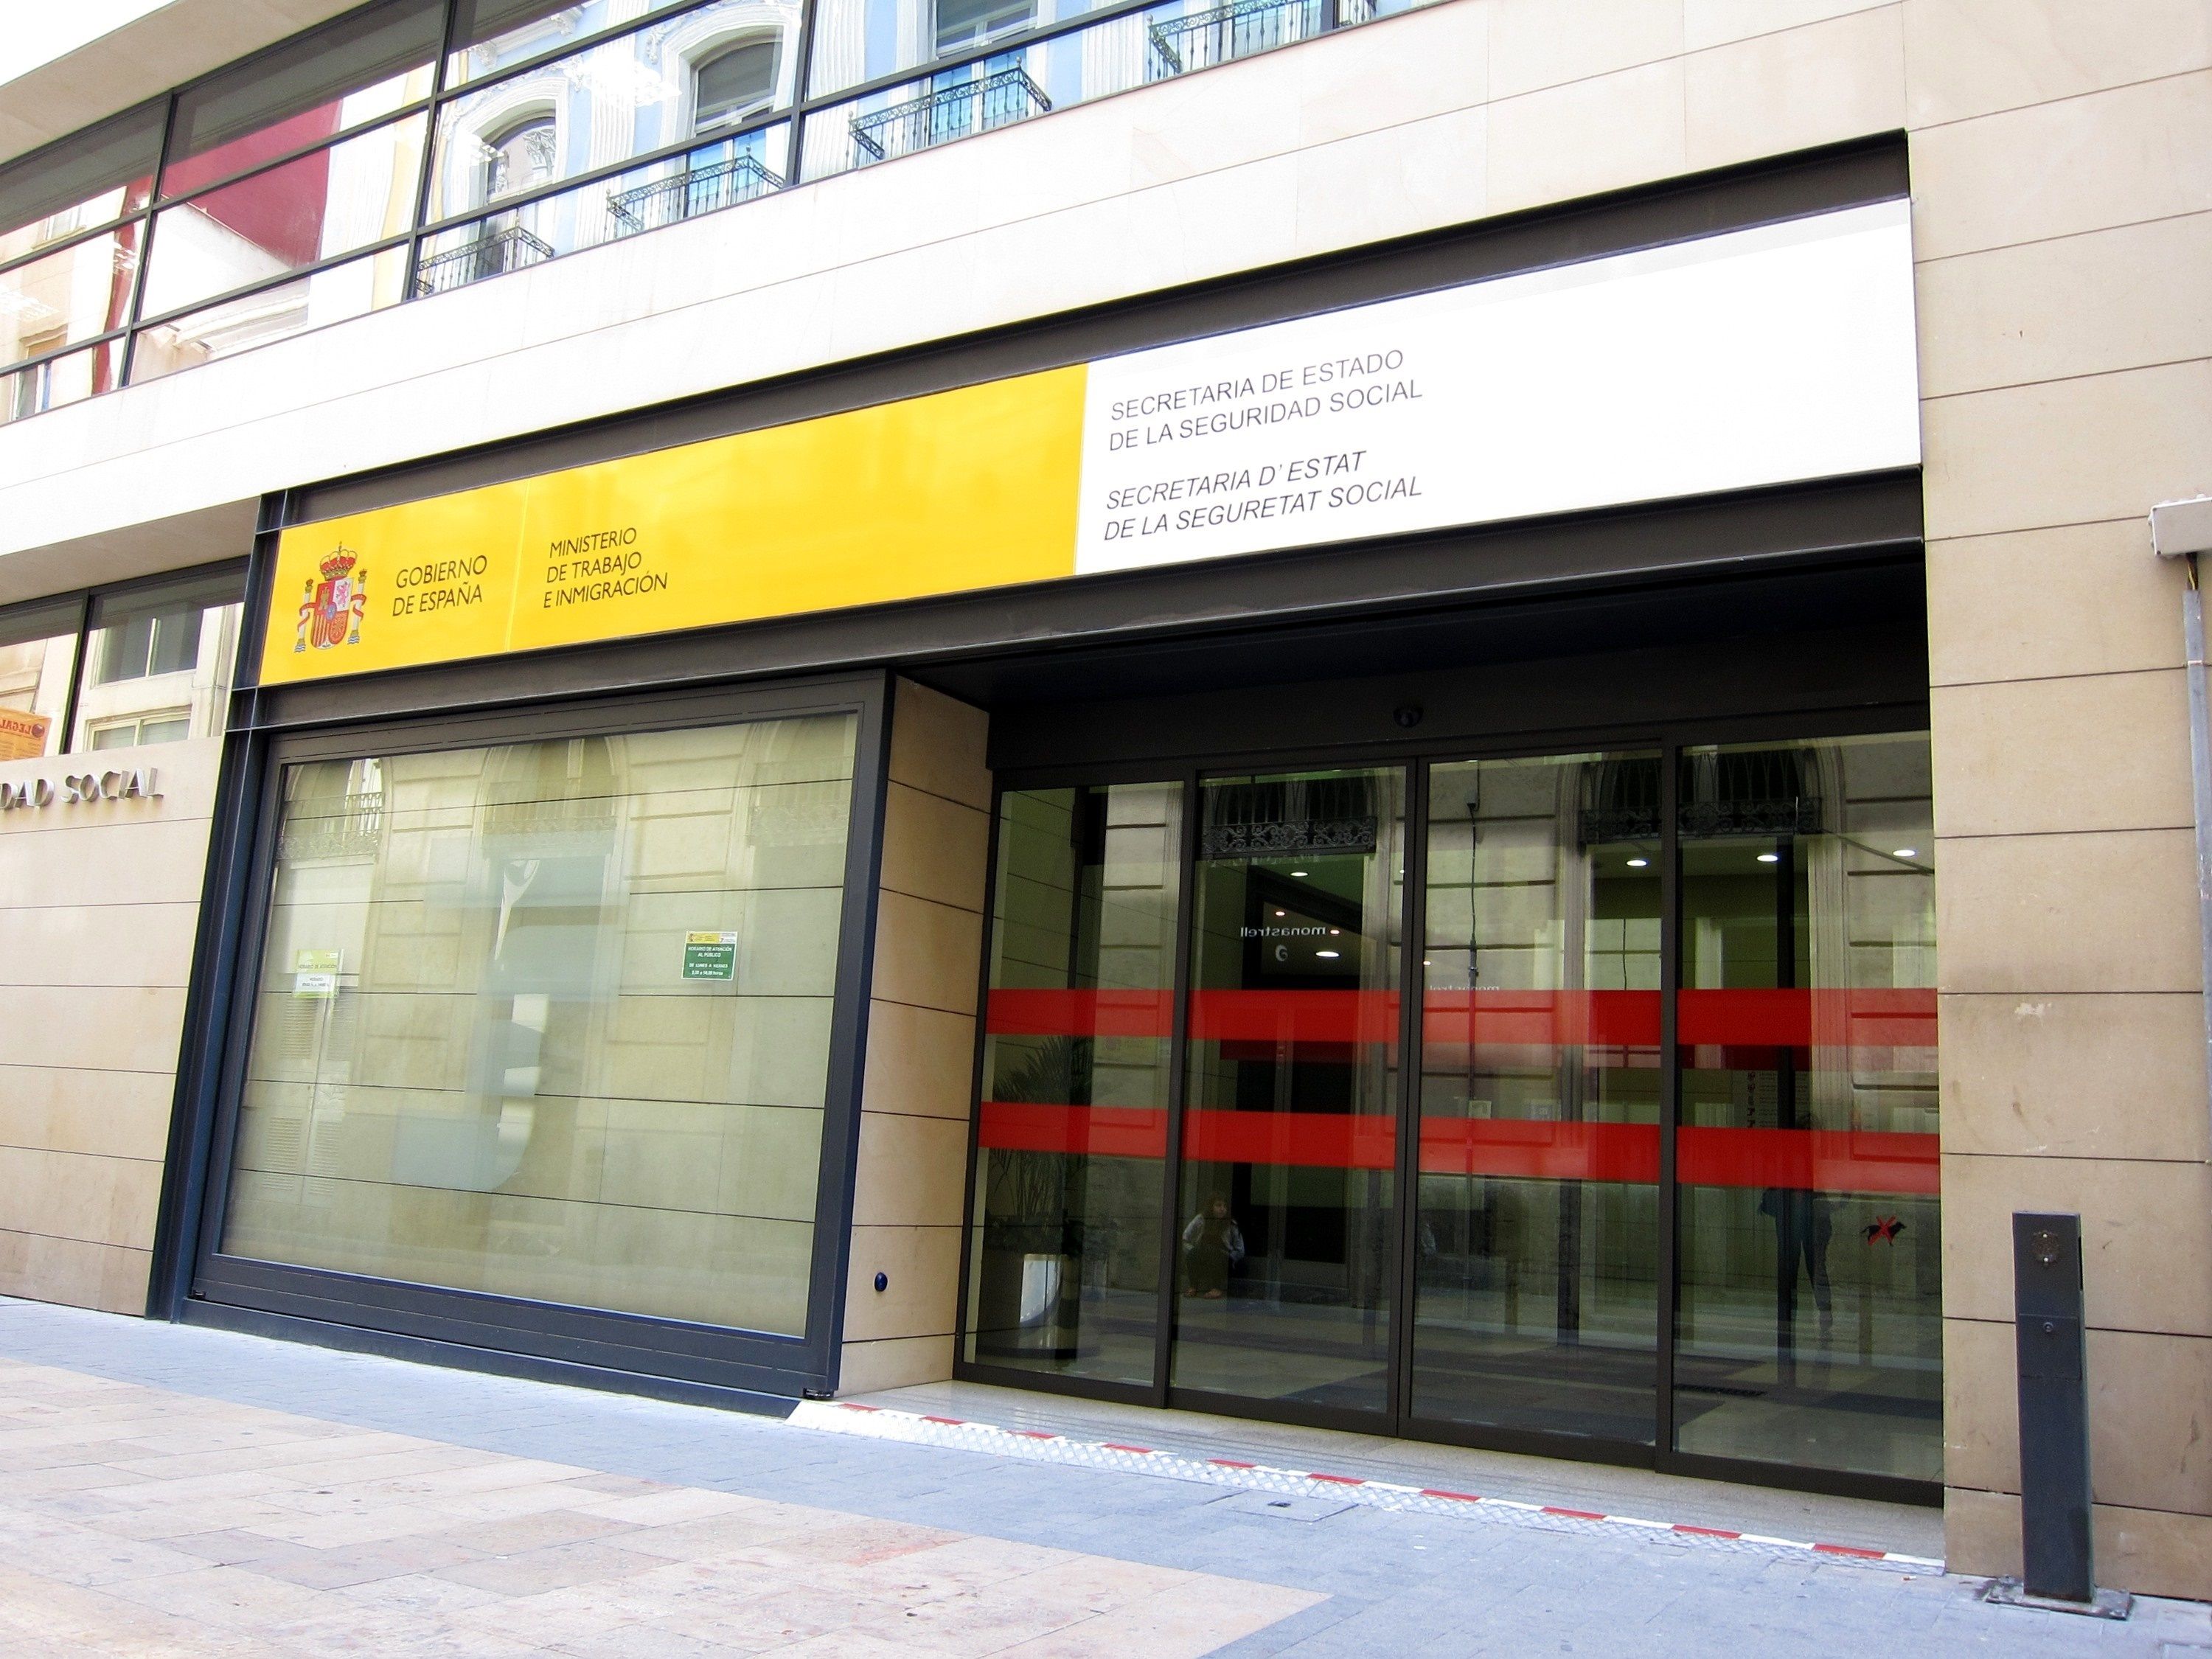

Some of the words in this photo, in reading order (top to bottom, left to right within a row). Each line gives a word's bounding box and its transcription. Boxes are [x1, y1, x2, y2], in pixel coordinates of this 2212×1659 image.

[1111, 378, 1255, 421] SECRETARIA
[1262, 369, 1293, 394] DE
[1302, 349, 1403, 386] ESTADO
[1110, 429, 1138, 451] DE
[1147, 423, 1173, 445] LA
[1180, 397, 1321, 439] SEGURIDAD
[1329, 379, 1423, 412] SOCIAL
[1107, 470, 1251, 509] SECRETARIA
[1287, 451, 1367, 482] ESTAT
[1104, 518, 1136, 540] DE
[1141, 514, 1168, 535] LA
[1175, 490, 1322, 531] SEGURETAT
[1328, 476, 1422, 508] SOCIAL
[549, 527, 636, 558] MINISTERIO
[395, 554, 487, 588] GOBIERNO
[546, 564, 567, 583] DE
[572, 552, 642, 578] TRABAJO
[392, 595, 417, 616] DE
[419, 582, 484, 613] ESPAÑA
[543, 591, 552, 608] E
[555, 571, 668, 606] INMIGRACIÓN
[60, 767, 164, 803] SOCIAL
